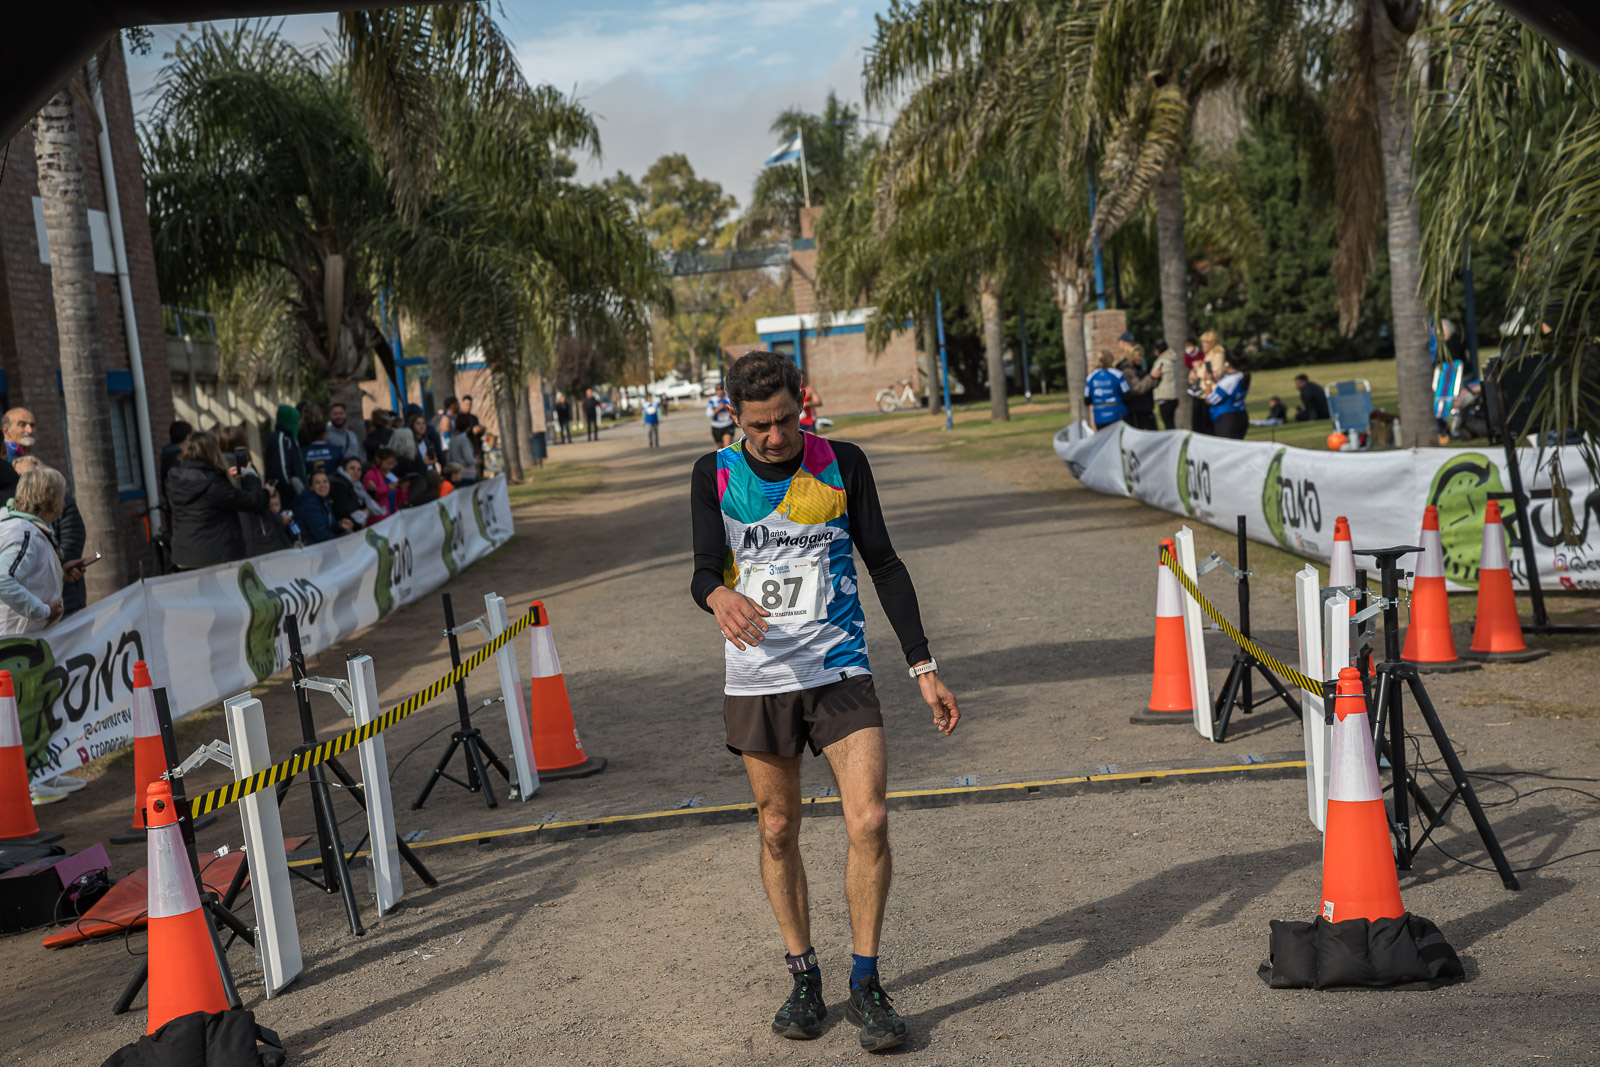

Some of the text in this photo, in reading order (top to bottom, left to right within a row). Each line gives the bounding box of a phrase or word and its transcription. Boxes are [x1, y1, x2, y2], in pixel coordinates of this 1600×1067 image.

[743, 524, 769, 549] 10
[776, 531, 834, 549] Magava
[762, 576, 803, 609] 87
